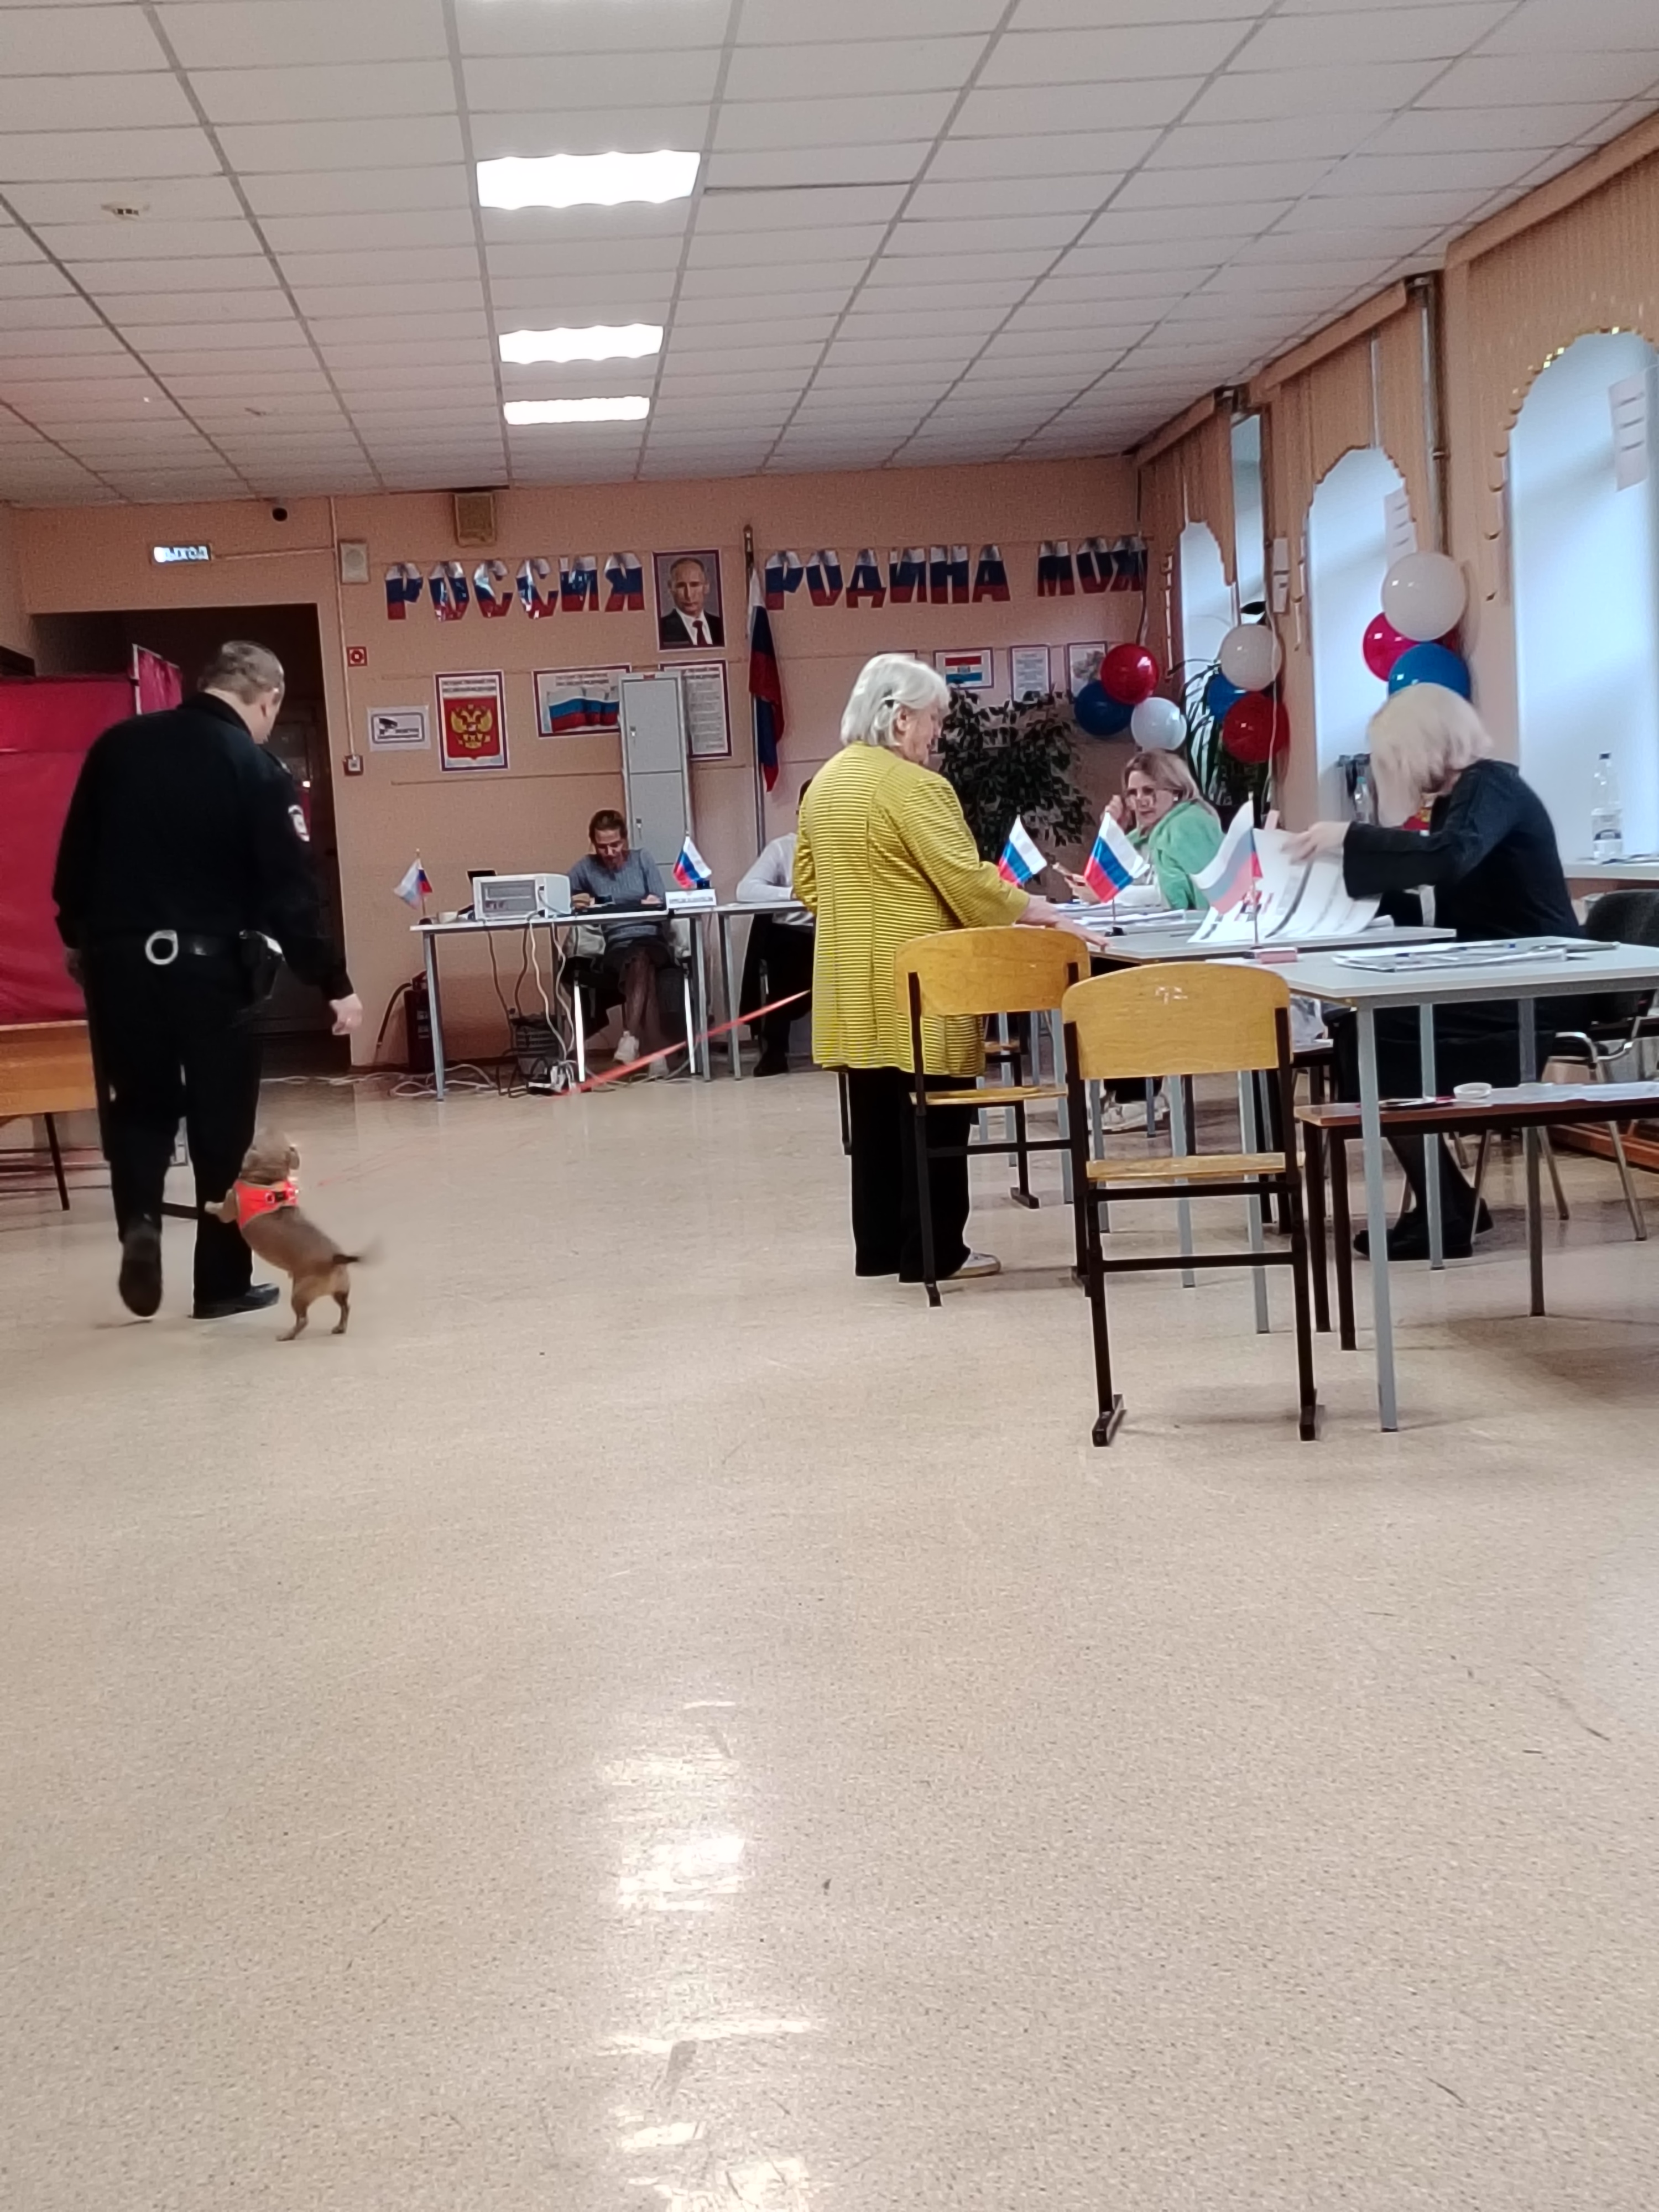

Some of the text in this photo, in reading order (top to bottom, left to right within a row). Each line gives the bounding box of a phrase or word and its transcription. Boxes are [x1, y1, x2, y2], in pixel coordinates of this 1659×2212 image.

[385, 534, 1148, 622] РОССИЯ РОДИНА МОЯ
